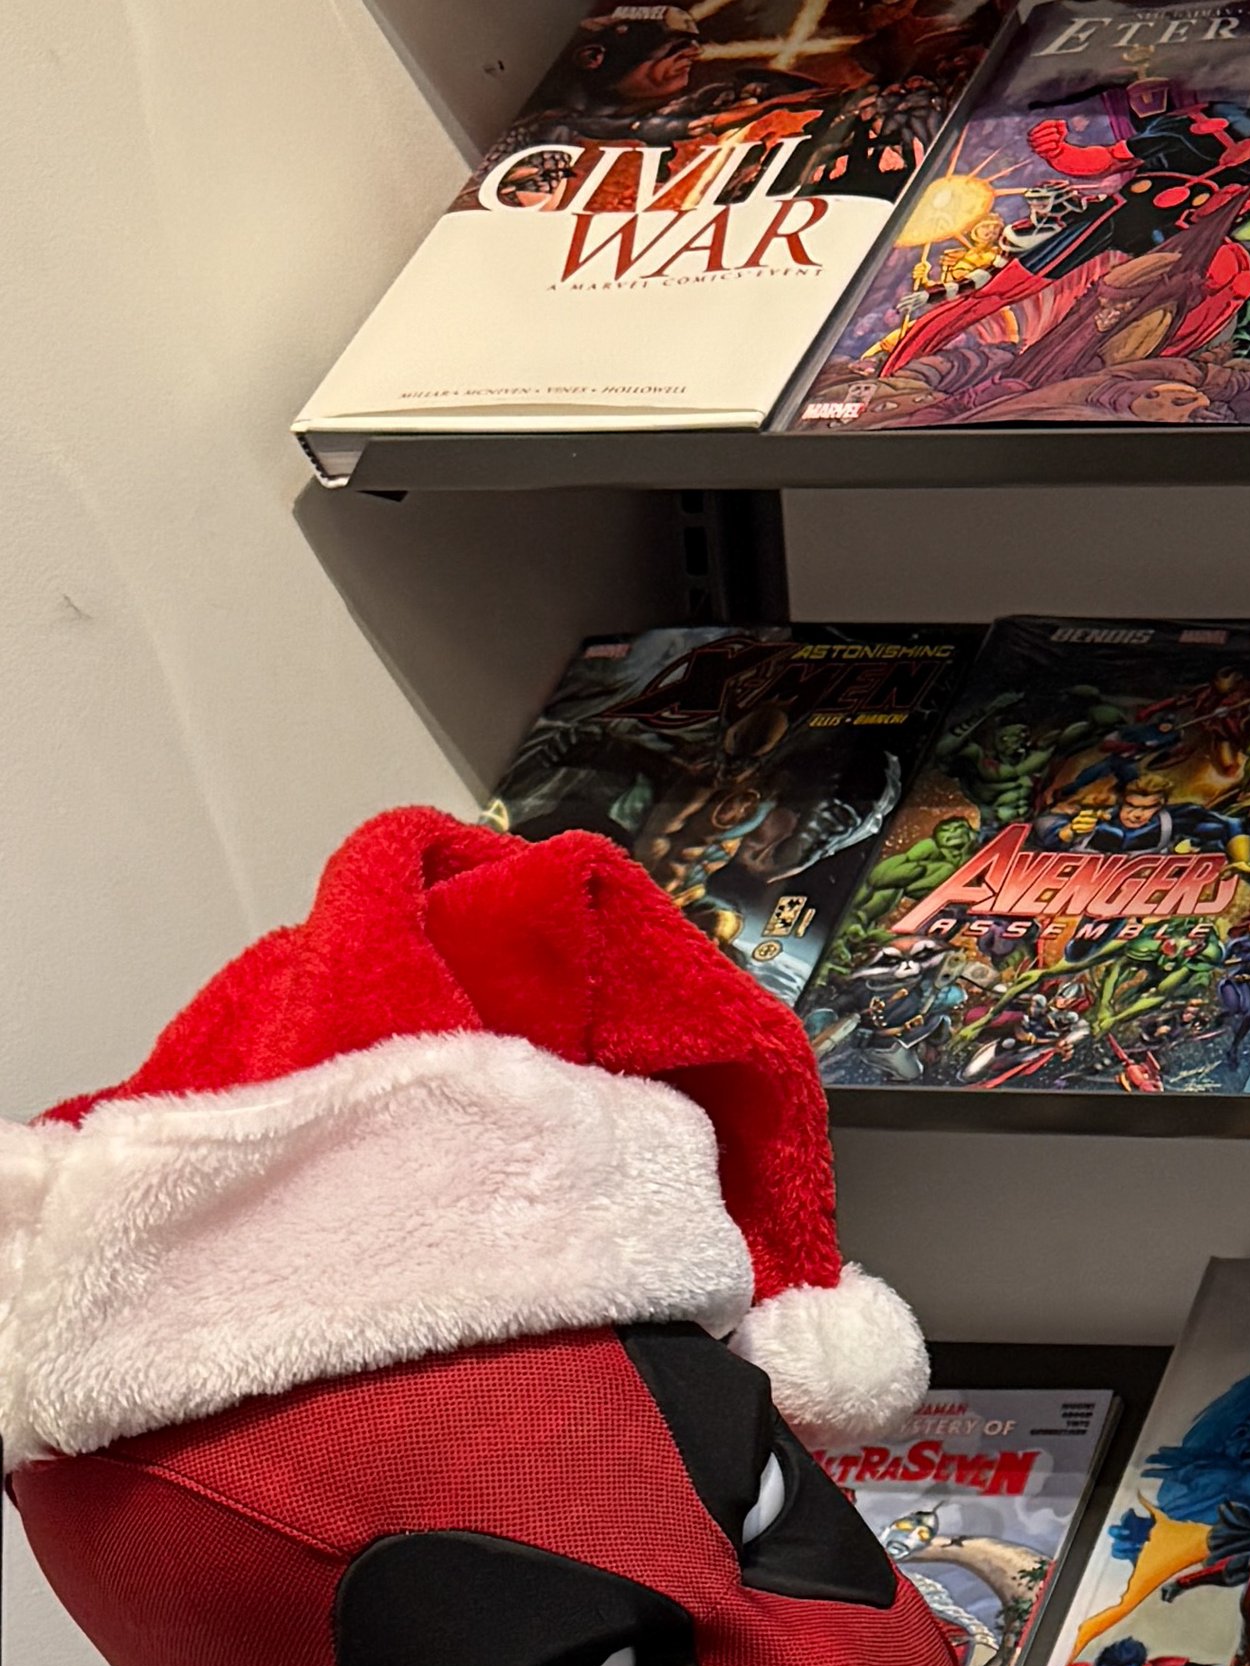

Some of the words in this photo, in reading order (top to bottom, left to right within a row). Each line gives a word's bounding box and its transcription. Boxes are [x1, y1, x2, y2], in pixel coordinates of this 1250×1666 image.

[478, 134, 812, 214] CIVIL
[561, 198, 829, 282] WAR
[571, 280, 650, 291] MARVEL
[662, 270, 742, 287] COMICS
[756, 268, 826, 279] EVENT
[801, 402, 866, 420] MARVEL
[790, 644, 955, 660] ASTONISHING
[890, 822, 1240, 935] AVENGERS
[928, 919, 1215, 942] ASSEMBLE
[900, 1417, 979, 1435] YSTERY
[984, 1419, 1017, 1436] OF
